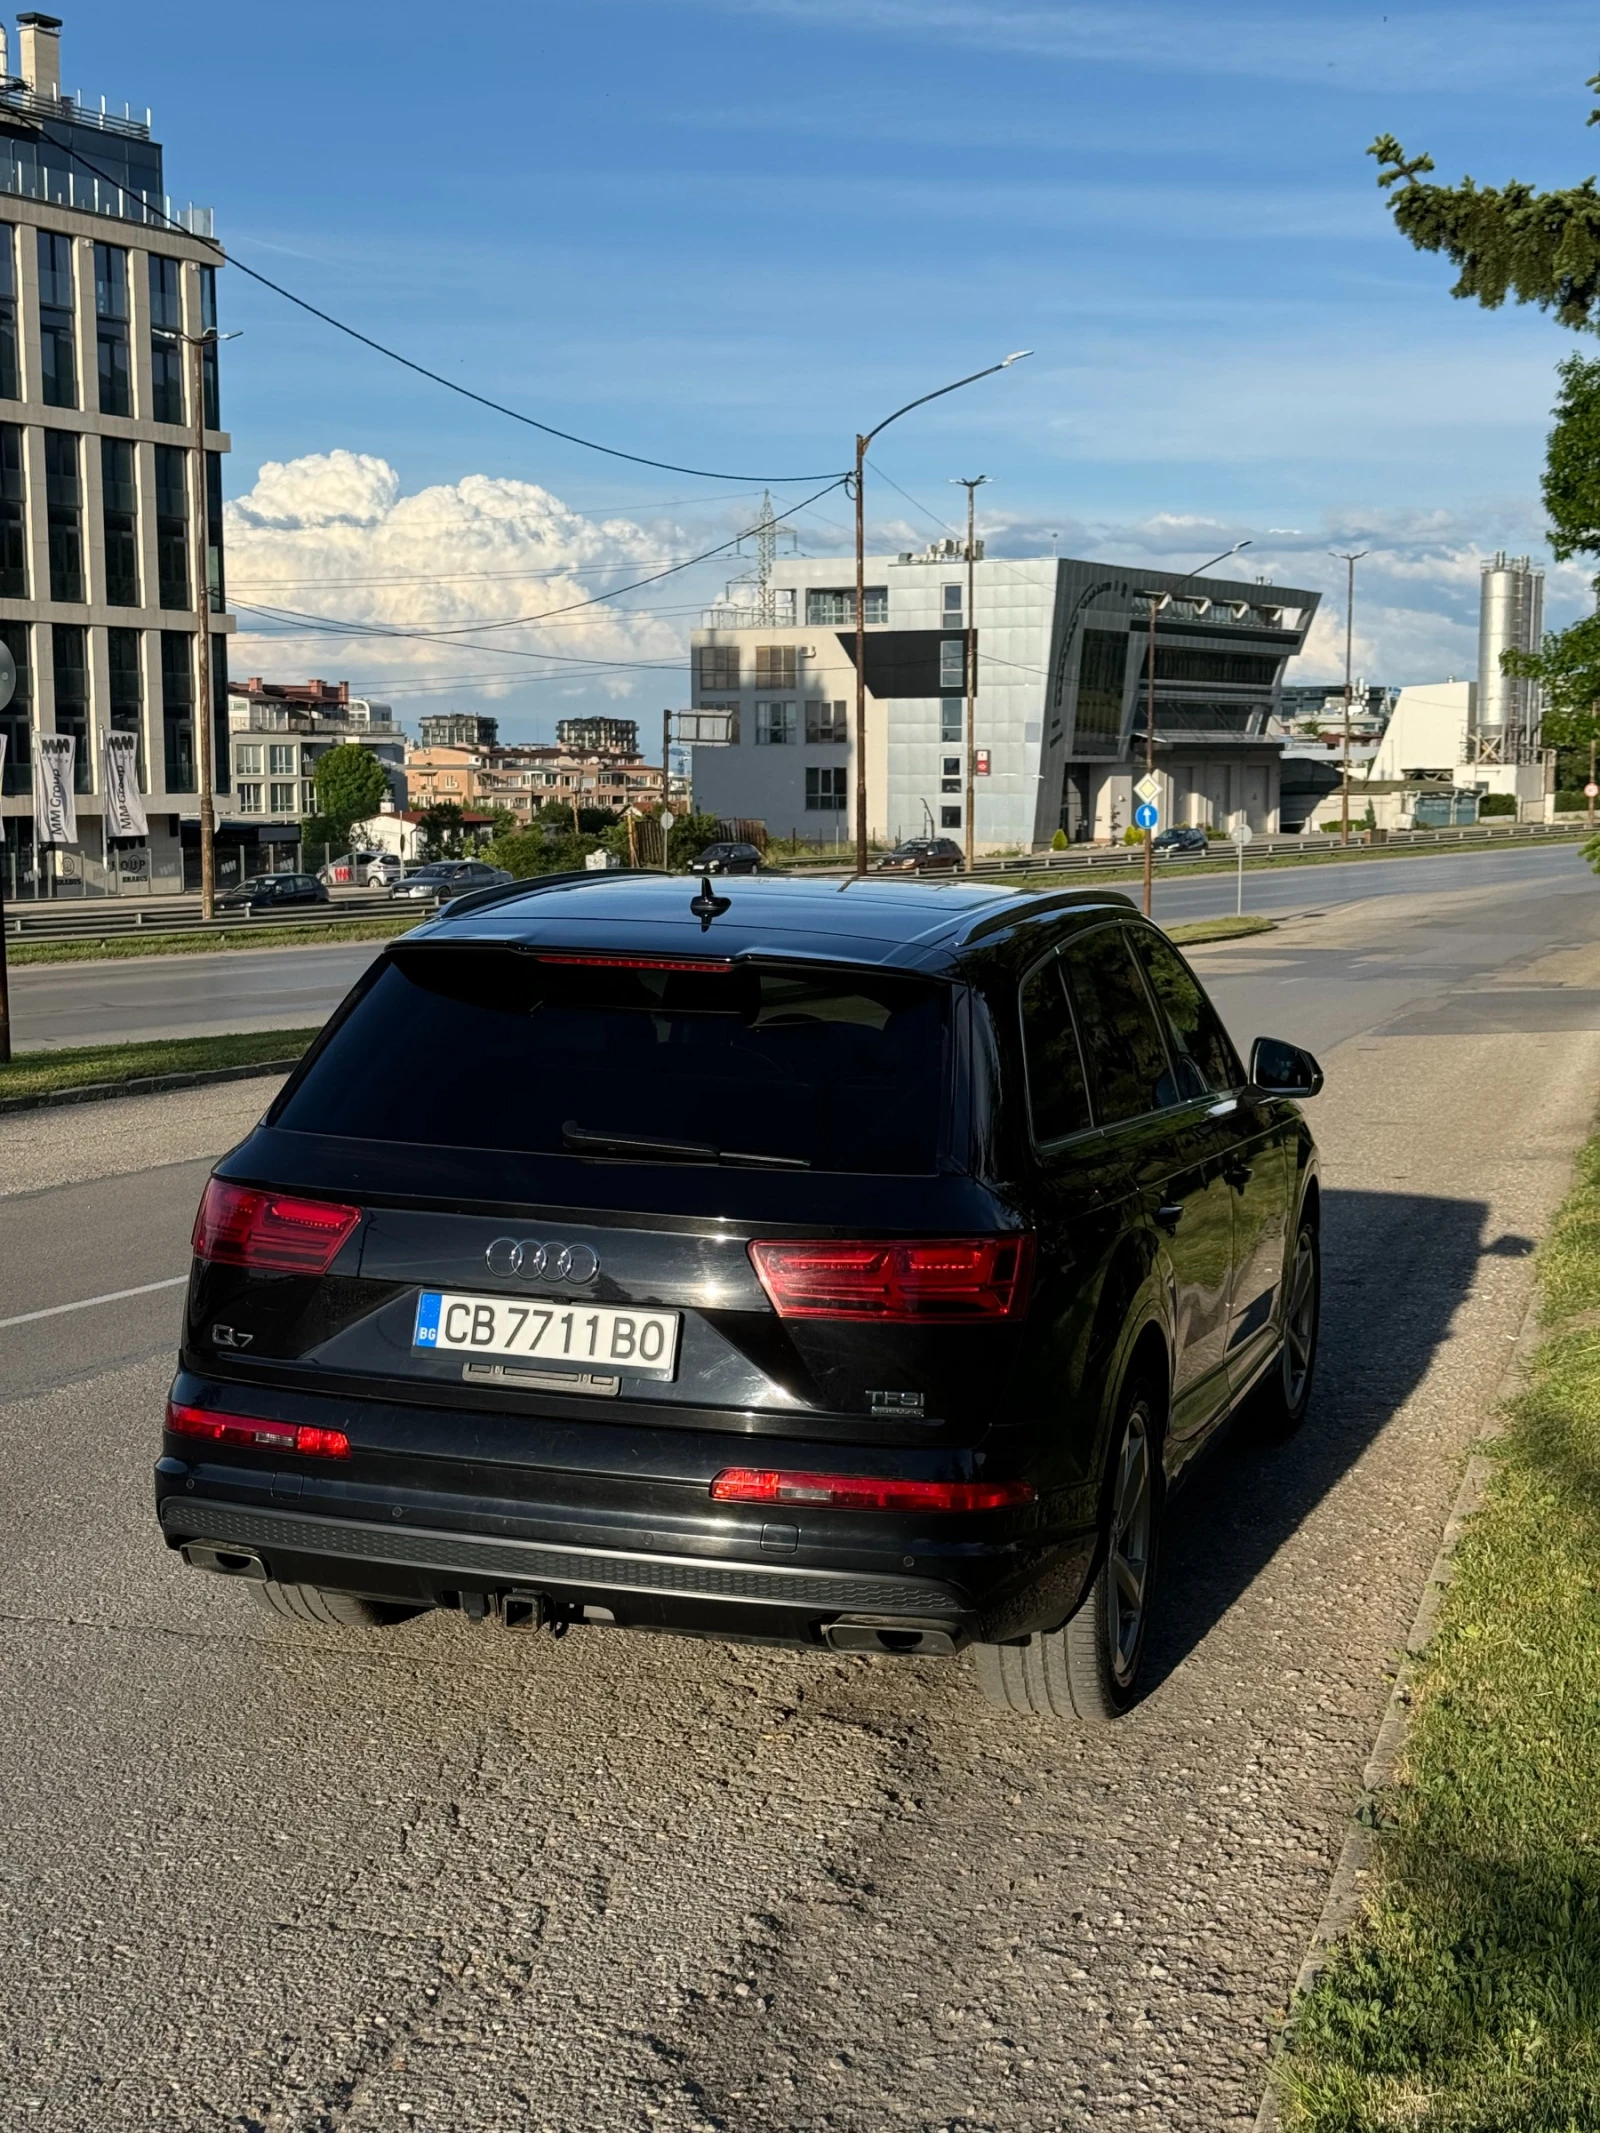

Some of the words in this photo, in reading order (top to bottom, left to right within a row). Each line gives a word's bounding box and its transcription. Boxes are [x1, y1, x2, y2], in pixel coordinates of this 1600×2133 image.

[50, 768, 62, 807] Group
[50, 810, 62, 835] MM
[119, 805, 132, 829] MM
[212, 1324, 254, 1347] Q7
[419, 1327, 437, 1341] BG
[865, 1390, 925, 1407] TFSI
